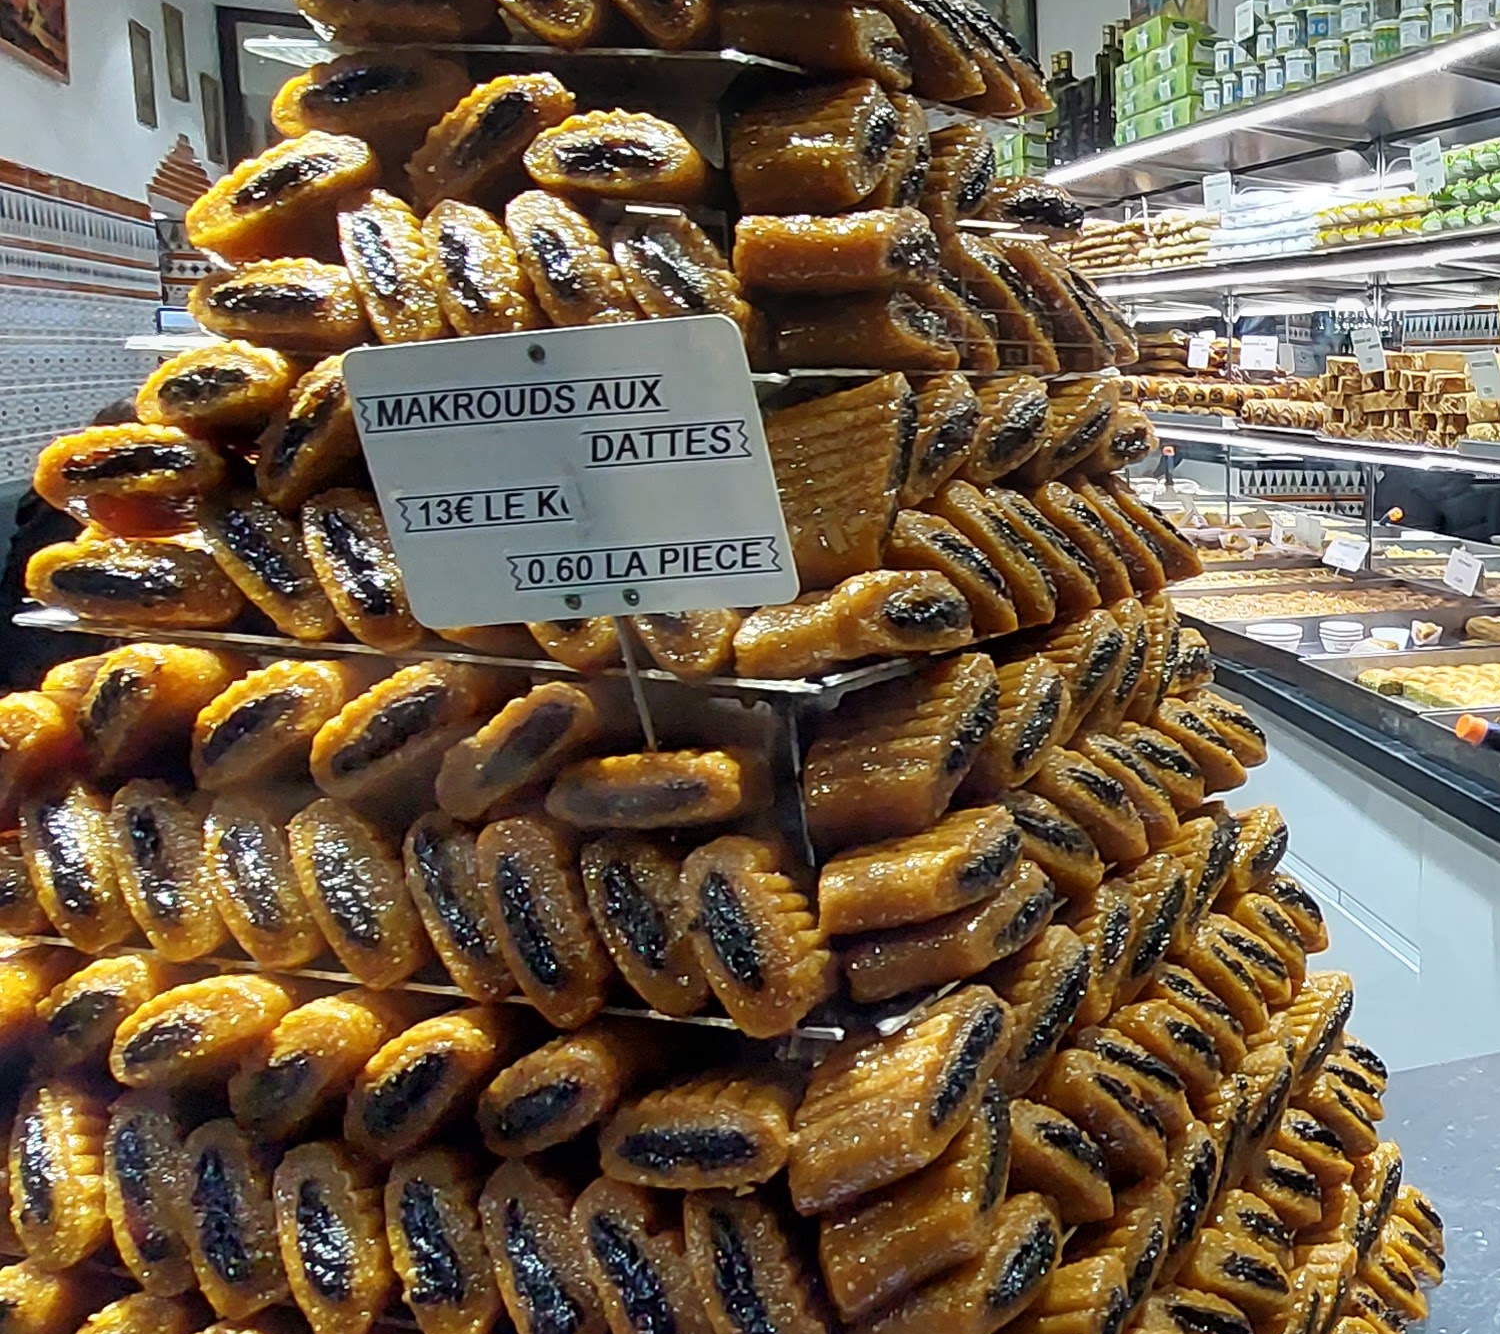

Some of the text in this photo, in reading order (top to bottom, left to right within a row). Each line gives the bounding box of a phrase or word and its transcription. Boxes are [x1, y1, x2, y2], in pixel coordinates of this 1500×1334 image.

[376, 378, 663, 427] MAKROUDS AUX
[591, 424, 732, 464] DATTES
[419, 496, 474, 526] 13€
[485, 492, 526, 521] LE
[527, 541, 763, 585] 0.60 LA PIECE
